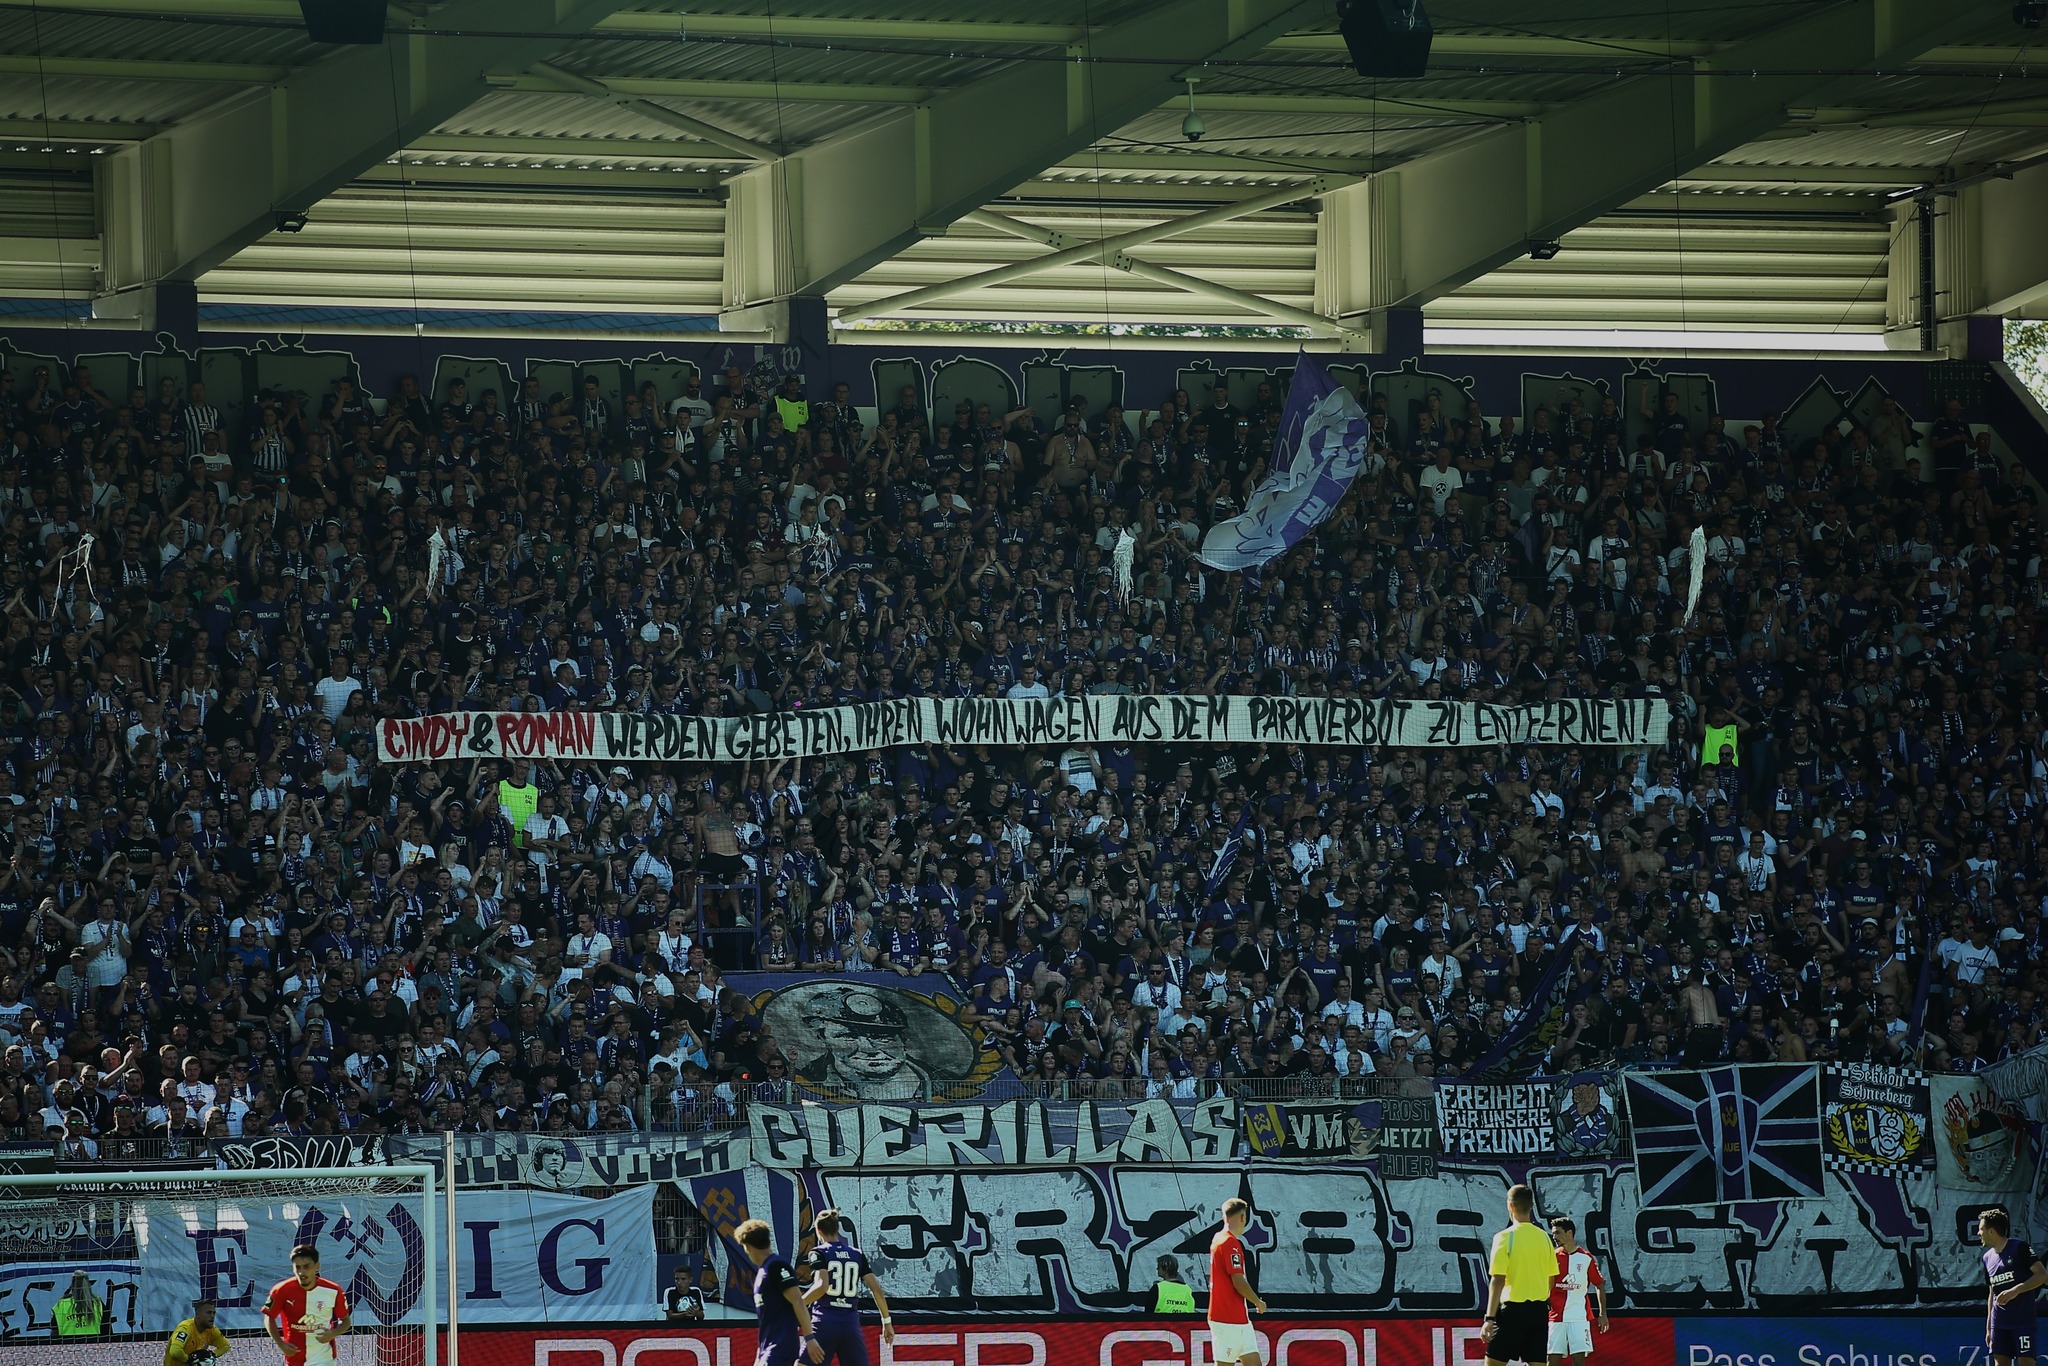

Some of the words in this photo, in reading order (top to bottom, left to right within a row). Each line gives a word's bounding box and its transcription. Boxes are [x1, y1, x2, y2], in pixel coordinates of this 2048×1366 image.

[601, 711, 717, 760] WERDEN
[724, 708, 851, 760] GEBETEN,
[853, 698, 922, 748] IHREN
[924, 696, 1099, 744] WOHNWAGEN
[1112, 696, 1162, 742] AUS
[1168, 696, 1230, 741] DEM
[1248, 697, 1412, 747] PARKVERBOT
[1426, 702, 1461, 745] ZU
[1474, 700, 1654, 744] ENTFERNEN!
[1850, 1063, 1905, 1089] Sektion
[1439, 1083, 1551, 1110] FREIHEIT
[1382, 1099, 1432, 1122] PROST
[1482, 1107, 1550, 1128] UNSERE
[760, 1098, 1236, 1170] GUERILLAS
[1380, 1127, 1433, 1148] JETZT
[1443, 1126, 1555, 1153] FREUNDE
[1381, 1154, 1434, 1177] HIER
[826, 1260, 860, 1298] 30
[2018, 1335, 2031, 1350] 15
